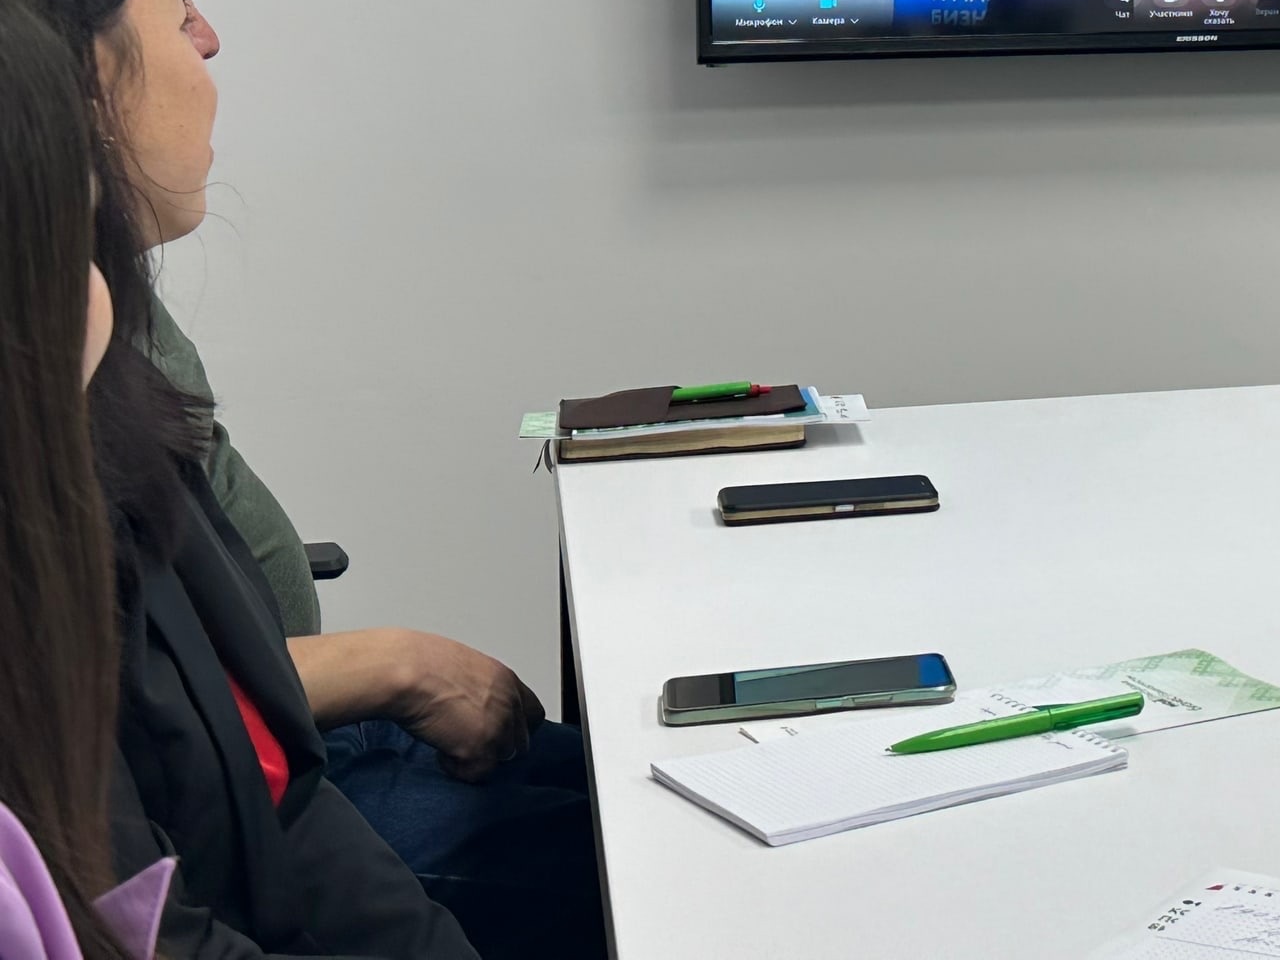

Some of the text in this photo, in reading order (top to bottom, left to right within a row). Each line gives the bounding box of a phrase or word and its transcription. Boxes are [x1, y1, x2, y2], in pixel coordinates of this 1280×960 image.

[1115, 11, 1130, 19] Чат
[1149, 10, 1193, 18] Участники
[1209, 9, 1229, 18] Хочу
[735, 18, 783, 28] Микрофон
[812, 17, 845, 26] Камера
